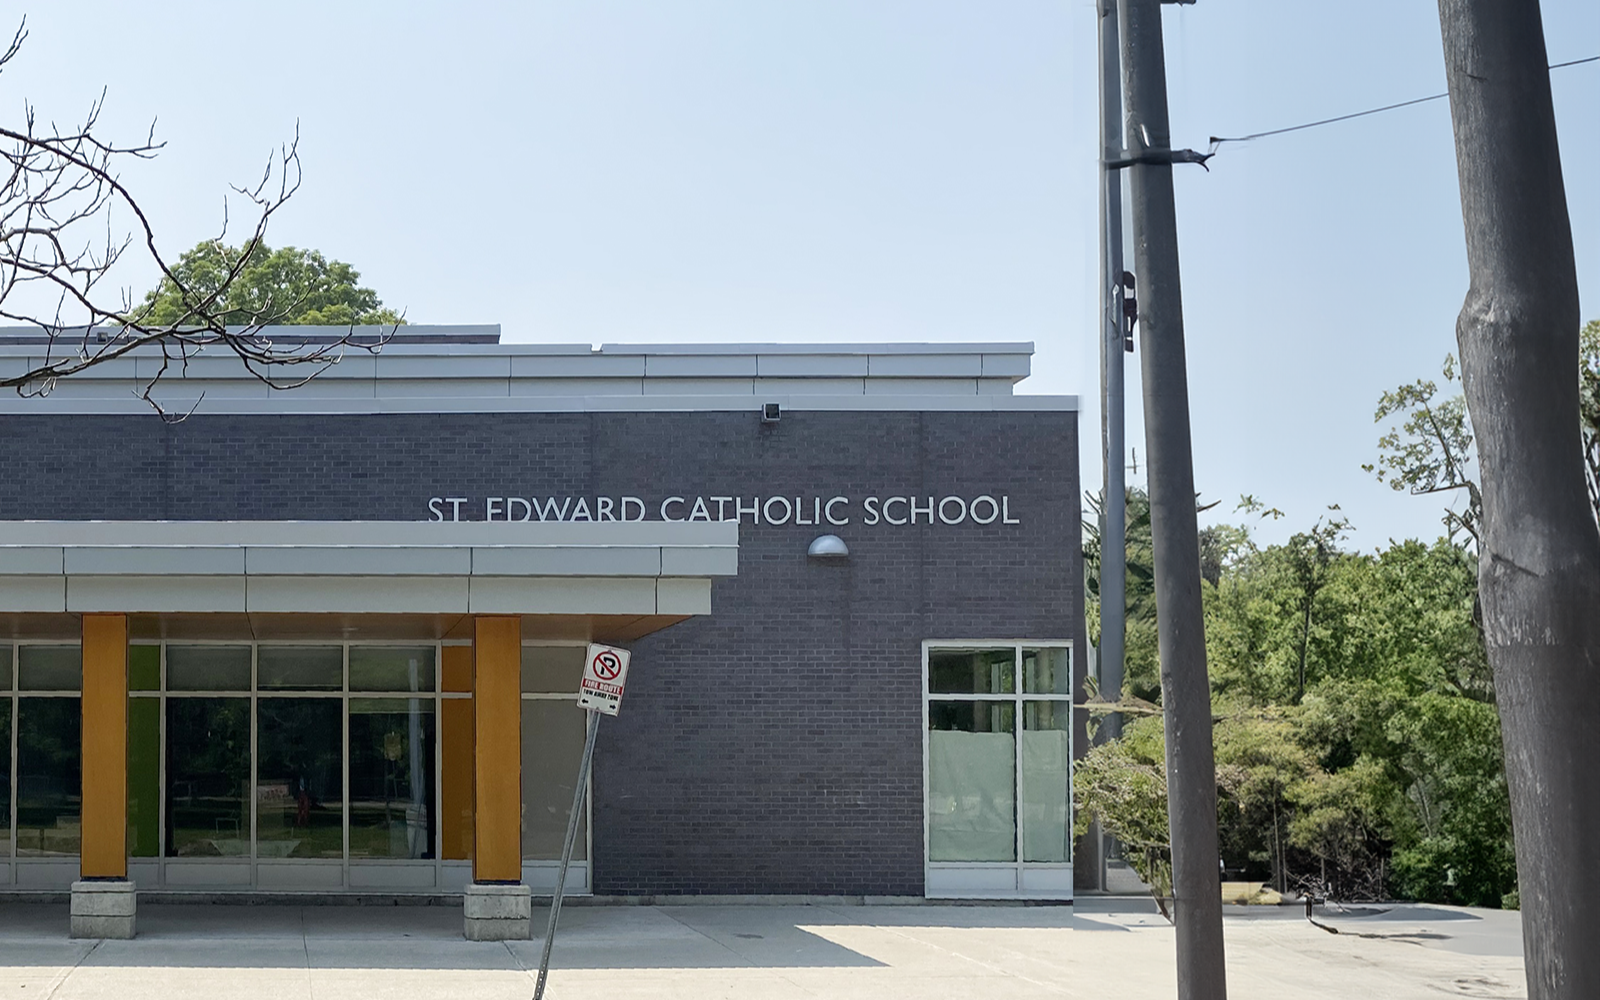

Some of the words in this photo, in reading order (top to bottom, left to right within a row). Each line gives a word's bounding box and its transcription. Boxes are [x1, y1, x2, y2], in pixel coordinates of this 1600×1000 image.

[428, 497, 470, 522] ST
[485, 496, 646, 522] EDWARD
[660, 496, 849, 525] CATHOLIC
[863, 495, 1020, 526] SCHOOL
[584, 679, 598, 689] FIRE
[599, 682, 620, 694] ROUTE
